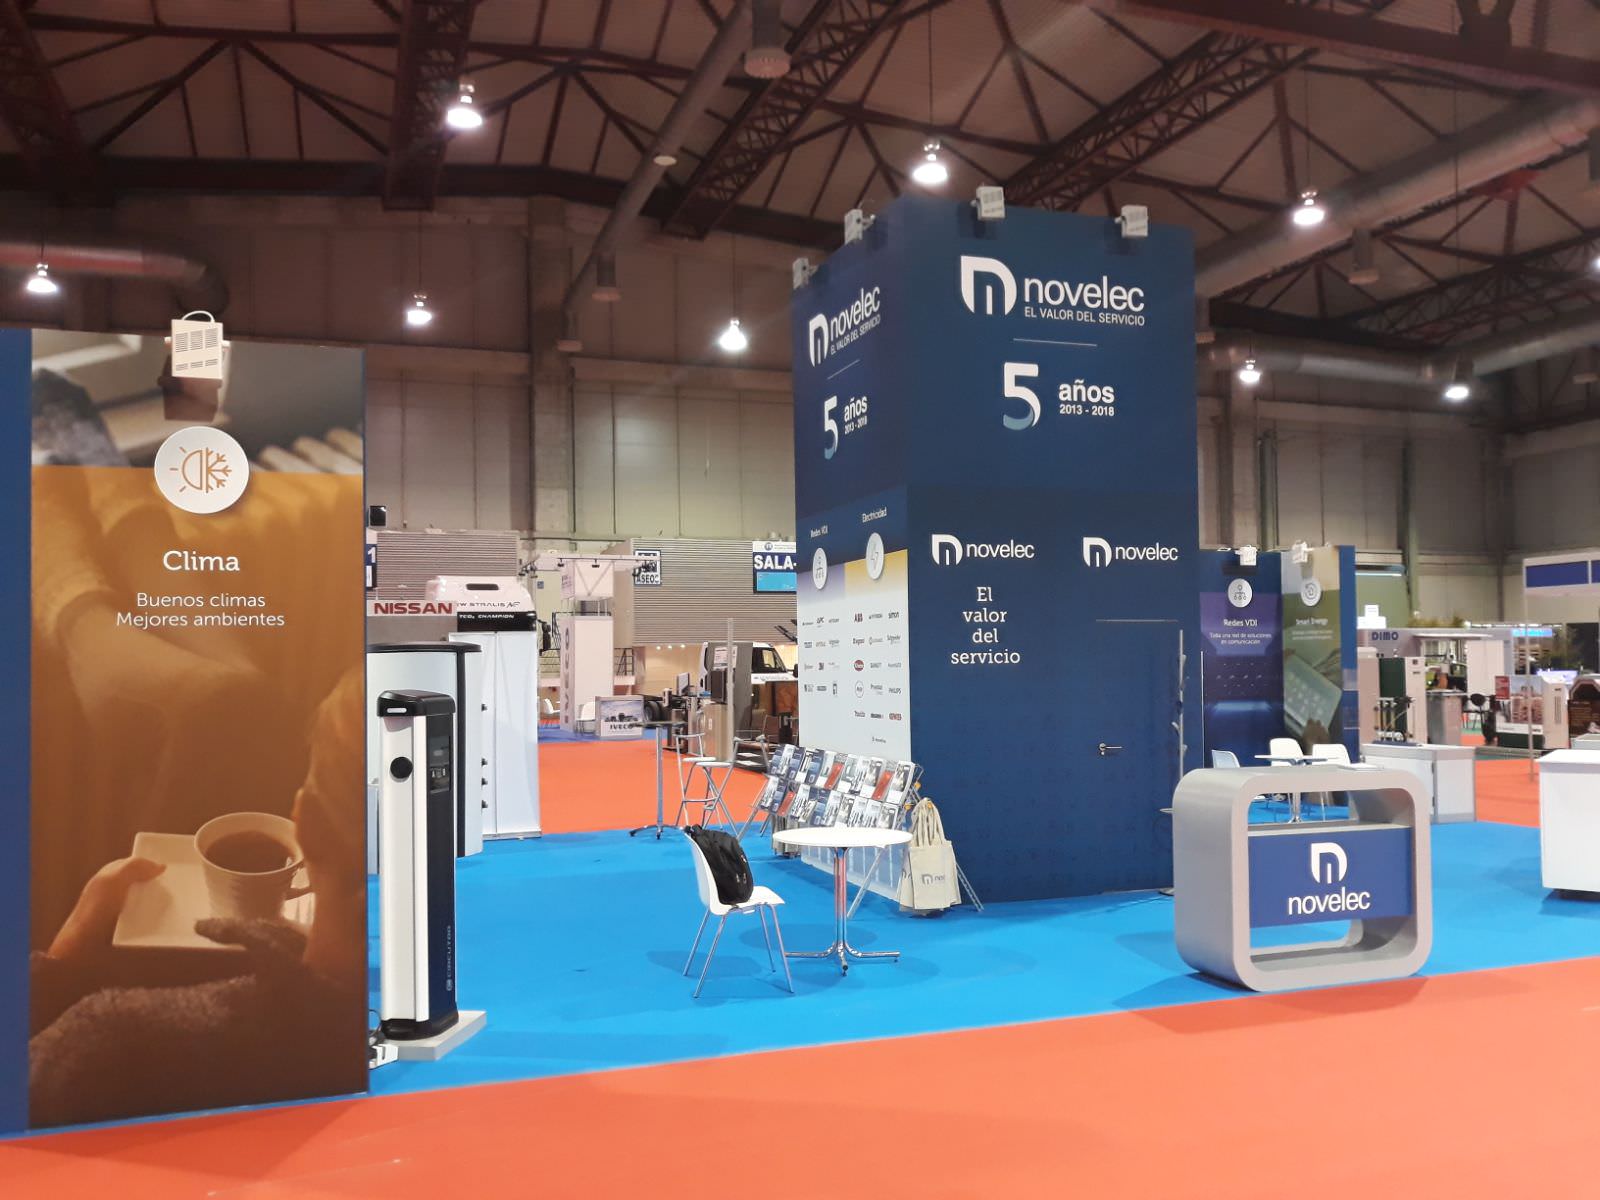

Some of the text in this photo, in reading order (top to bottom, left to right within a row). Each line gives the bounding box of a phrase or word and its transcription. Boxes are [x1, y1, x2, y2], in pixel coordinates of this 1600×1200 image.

[1024, 275, 1145, 312] novelec
[830, 286, 880, 341] novelec
[1024, 306, 1145, 327] EL VALOR DEL SERVICIO
[836, 334, 850, 351] VALOR
[859, 313, 881, 336] SERVICIO
[1003, 361, 1115, 431] 5 años
[1059, 403, 1083, 415] 2013
[1091, 405, 1115, 417] 2018
[824, 395, 868, 460] 5 años
[966, 539, 1035, 559] novelec
[1115, 542, 1178, 561] novelec
[163, 550, 240, 571] Clima
[136, 592, 266, 607] Buenos climas
[976, 586, 993, 602] El
[373, 602, 453, 615] NISSAN
[962, 607, 1008, 623] valor
[116, 612, 285, 630] Mejores ambientes
[1223, 618, 1258, 627] Redes VDI
[972, 628, 998, 644] del
[1371, 631, 1399, 641] DIMO
[950, 649, 1021, 664] servicio
[1288, 886, 1371, 915] novelec
